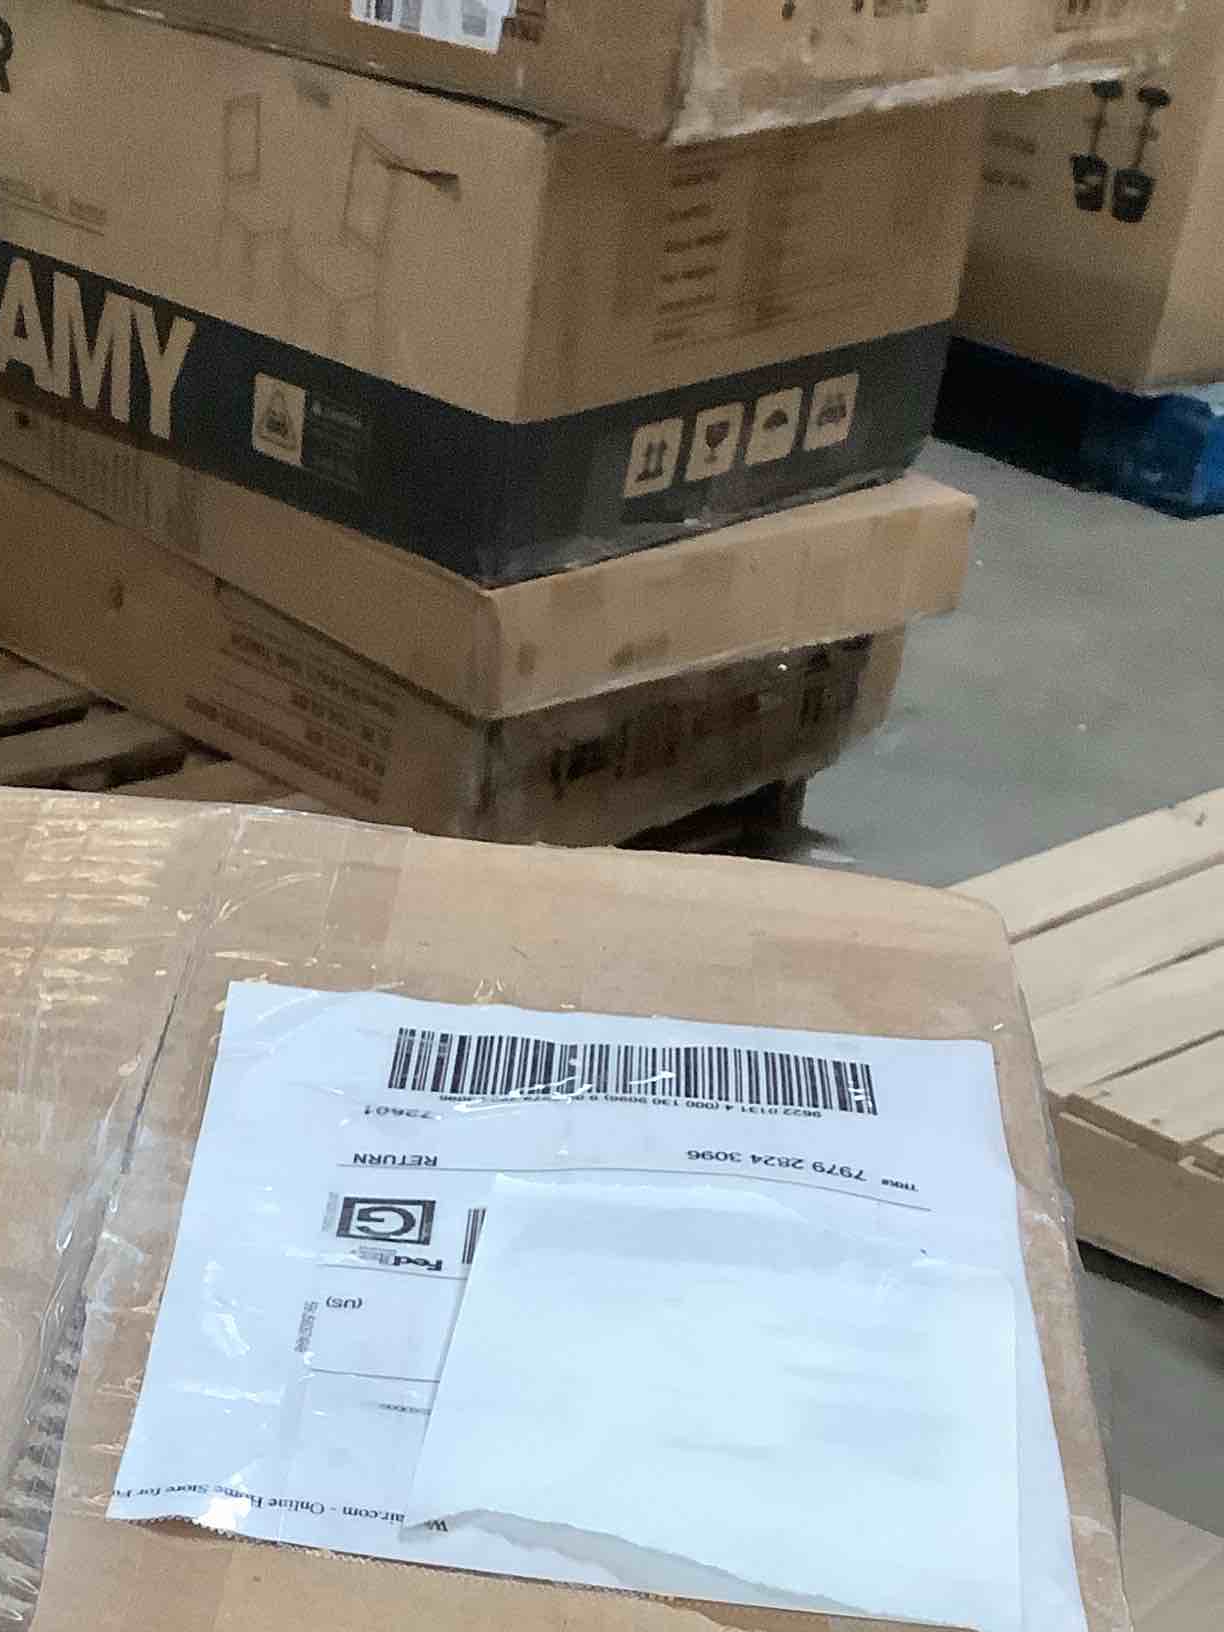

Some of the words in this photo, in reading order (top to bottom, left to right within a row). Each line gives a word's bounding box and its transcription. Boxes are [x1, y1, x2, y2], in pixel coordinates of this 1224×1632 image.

[352, 1153, 438, 1167] RETURN
[687, 1150, 743, 1164] 3096
[749, 1153, 805, 1171] 2824
[811, 1161, 868, 1182] 7979
[356, 1206, 417, 1239] G
[325, 1295, 364, 1310] (US)
[268, 1498, 325, 1515] Online
[342, 1506, 449, 1533] Wair.com
